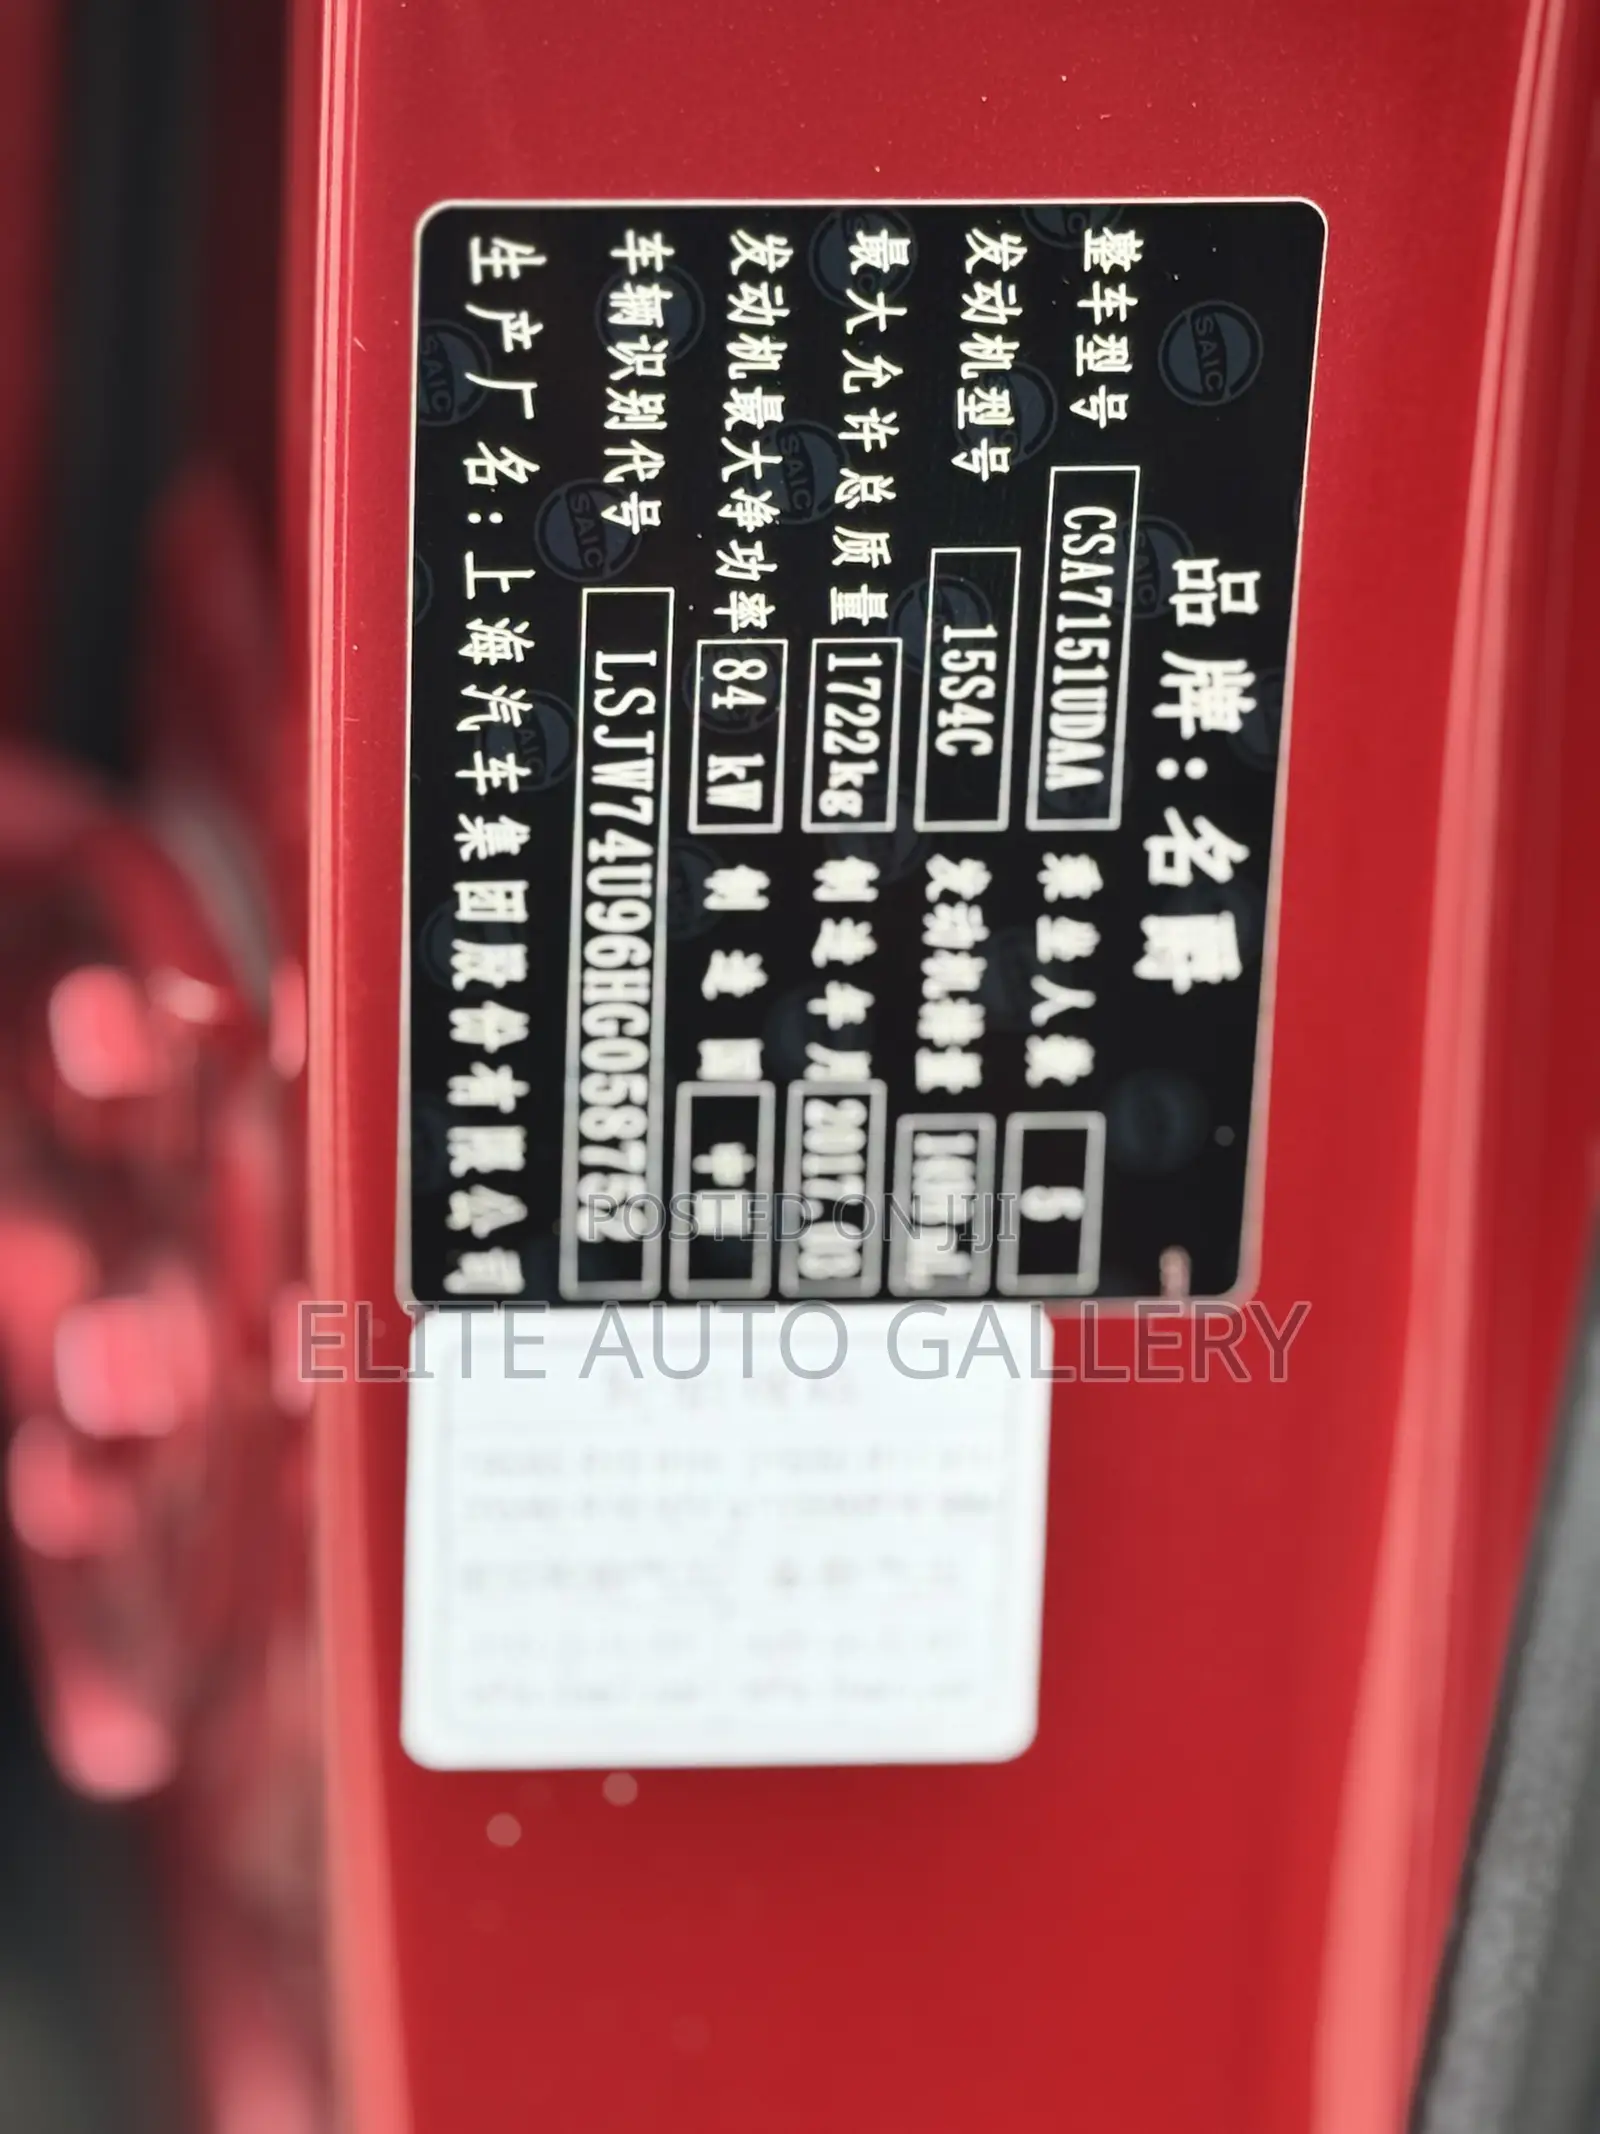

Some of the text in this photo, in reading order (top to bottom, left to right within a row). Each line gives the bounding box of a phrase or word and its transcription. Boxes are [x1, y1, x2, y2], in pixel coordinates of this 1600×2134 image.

[601, 230, 674, 535] 车辆识别代号
[951, 228, 1027, 482] 发动机型号
[1070, 227, 1143, 428] 整车型号
[1192, 314, 1224, 391] SAIC
[714, 230, 793, 633] 发动机最大净功率
[778, 431, 815, 511] SAIC
[830, 229, 911, 626] 最大允许总质量
[567, 493, 607, 569] SAIC
[707, 658, 767, 811] 84 kW
[936, 623, 998, 757] 15S4C
[1042, 506, 1117, 790] CSA7151UDAA
[1020, 1185, 1086, 1223] 5
